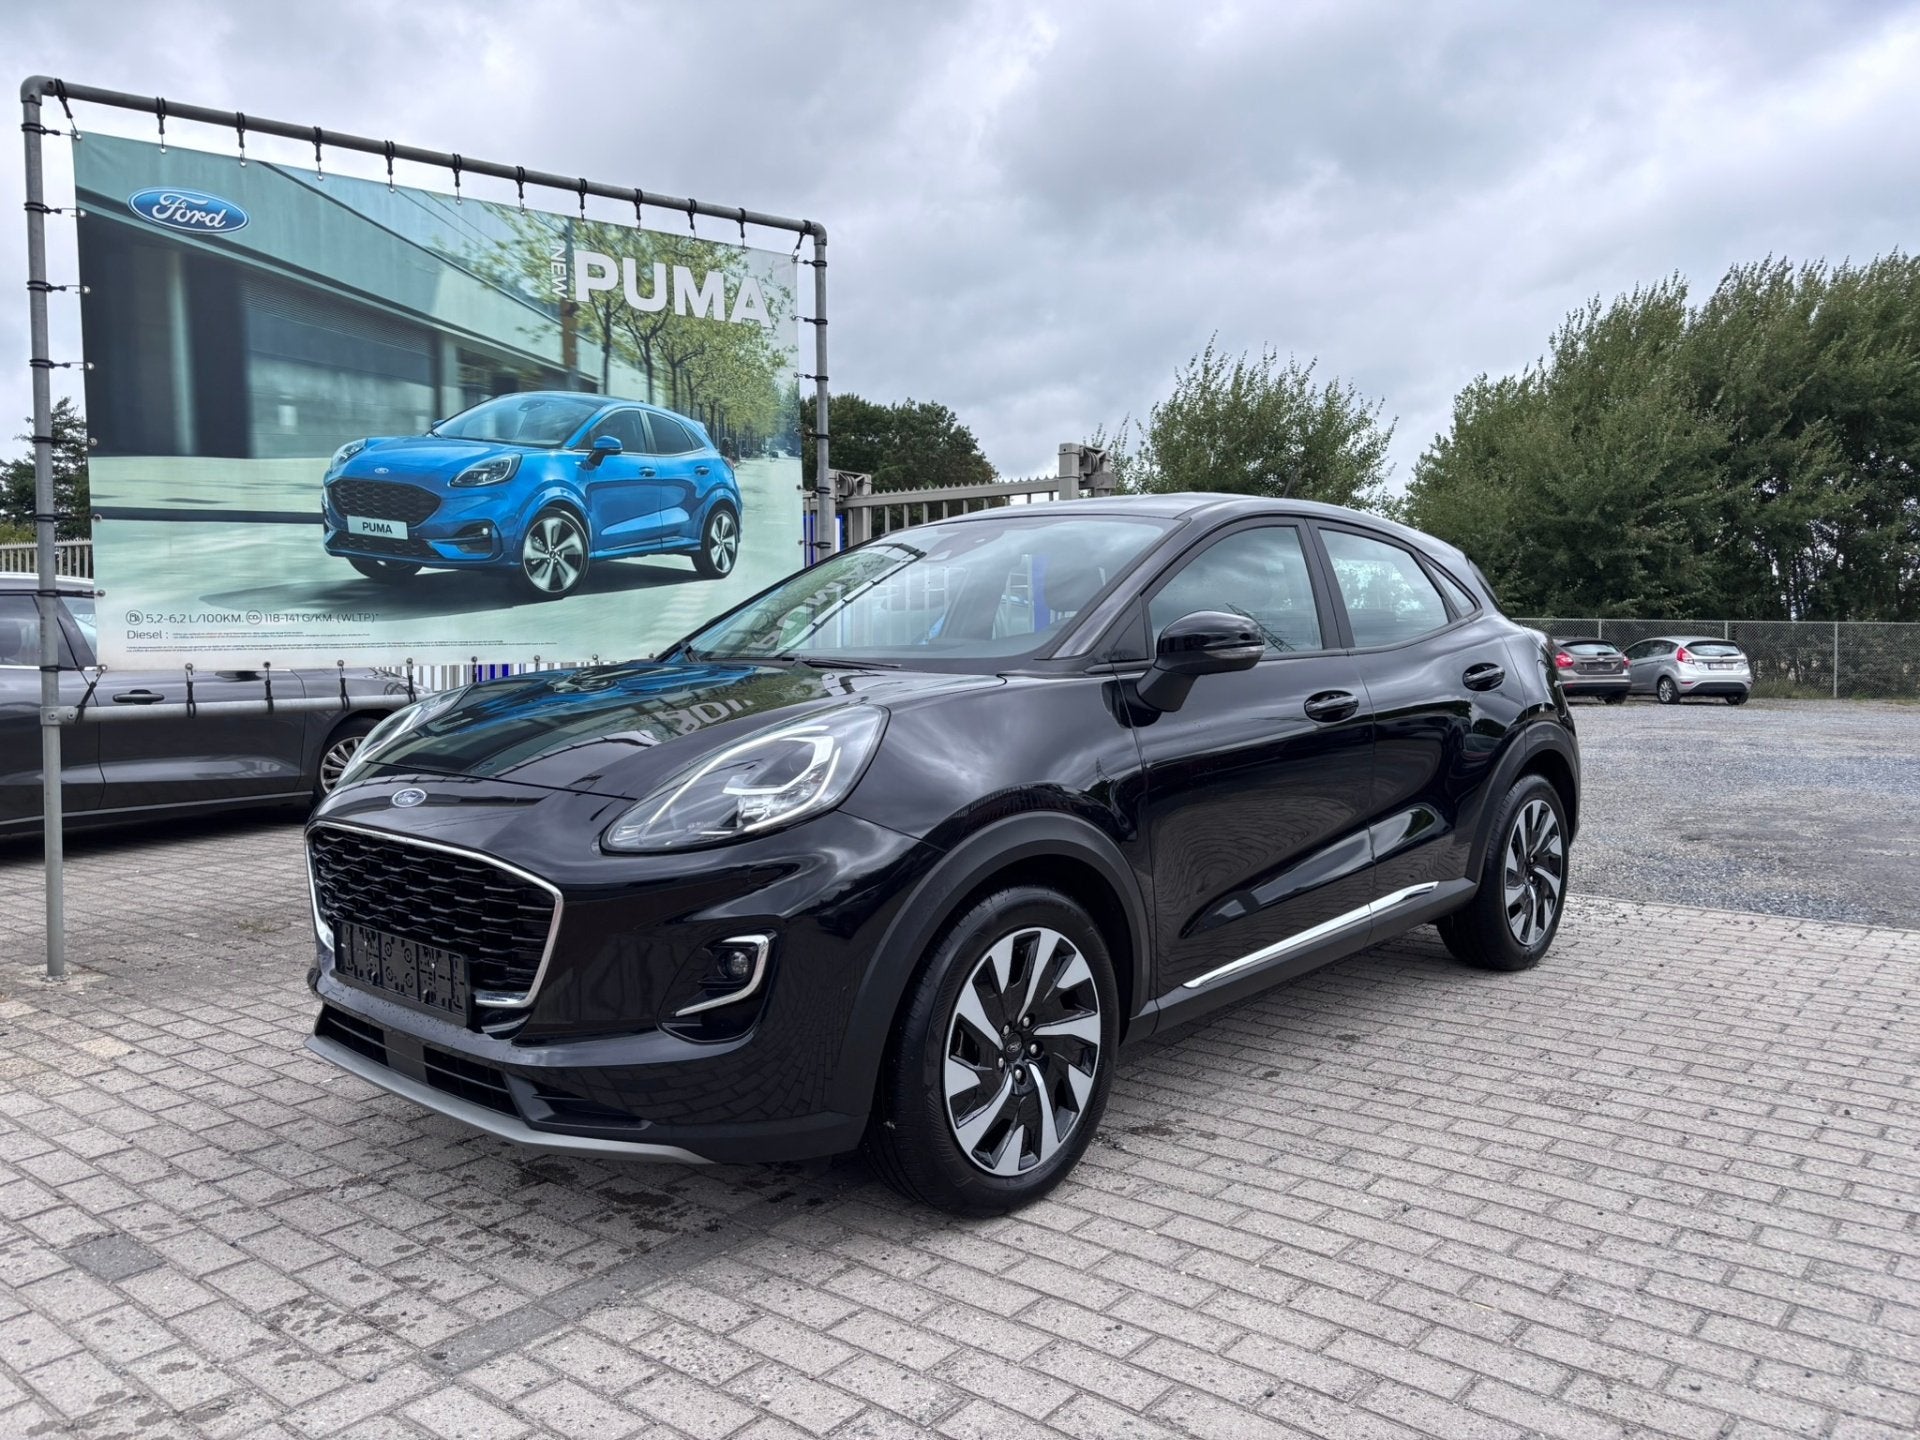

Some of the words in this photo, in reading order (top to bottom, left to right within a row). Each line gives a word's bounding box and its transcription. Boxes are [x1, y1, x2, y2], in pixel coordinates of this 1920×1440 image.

[151, 192, 226, 228] Ford
[550, 245, 568, 299] NEW
[574, 249, 773, 329] PUMA
[362, 521, 393, 534] PUMA
[264, 613, 299, 623] 118-141
[126, 629, 163, 640] Diesel
